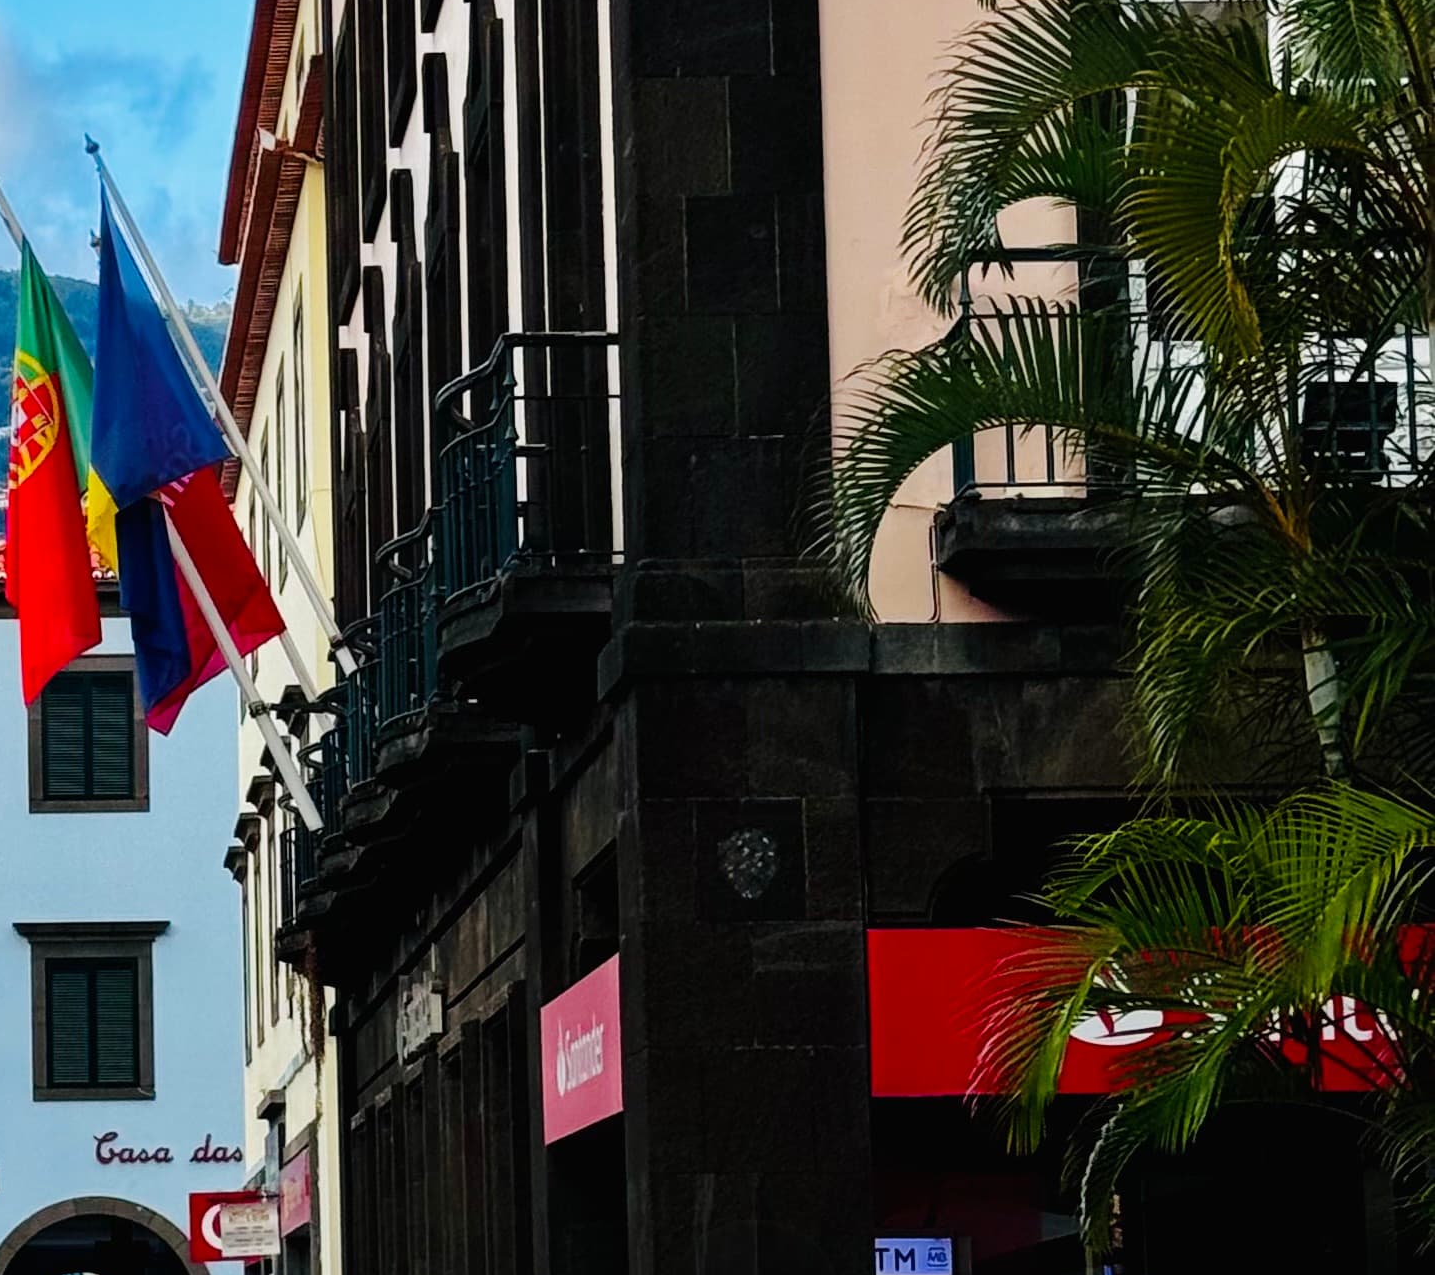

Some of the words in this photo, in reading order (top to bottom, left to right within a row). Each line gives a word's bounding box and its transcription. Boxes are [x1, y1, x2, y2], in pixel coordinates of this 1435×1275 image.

[93, 1132, 174, 1164] Casa
[190, 1133, 243, 1163] das
[875, 1247, 916, 1272] TM
